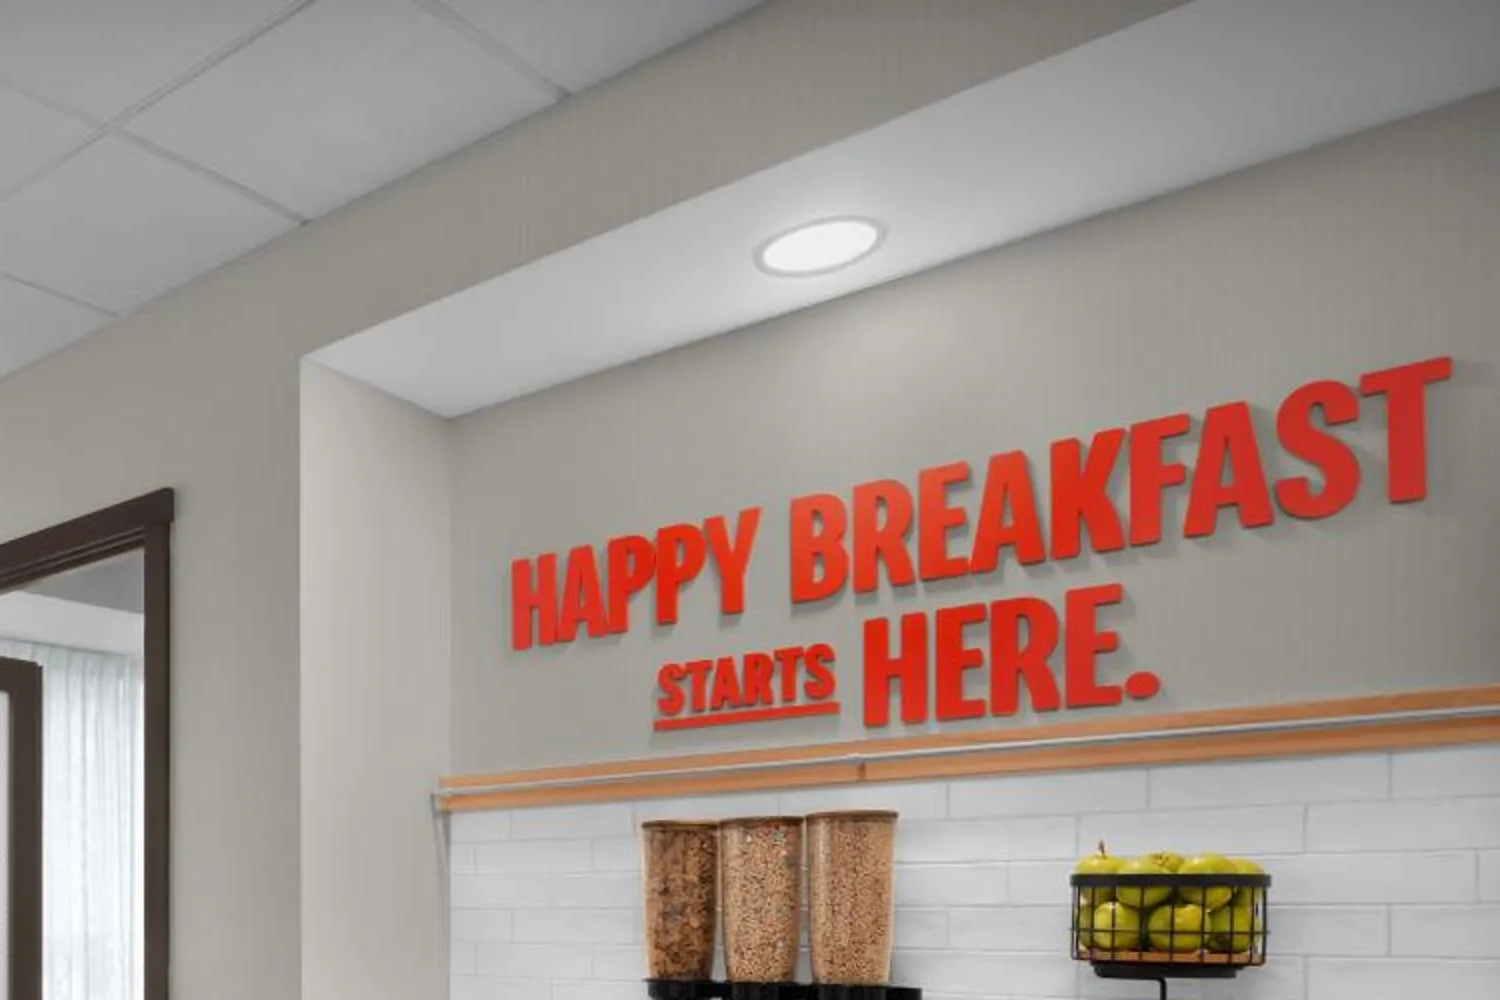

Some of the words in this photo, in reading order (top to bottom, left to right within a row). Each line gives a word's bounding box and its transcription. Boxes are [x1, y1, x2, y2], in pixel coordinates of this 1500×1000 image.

[511, 507, 762, 651] HAPPY
[789, 356, 1453, 603] BREAKFAST
[656, 643, 836, 715] STARTS
[862, 583, 1160, 727] HERE.
